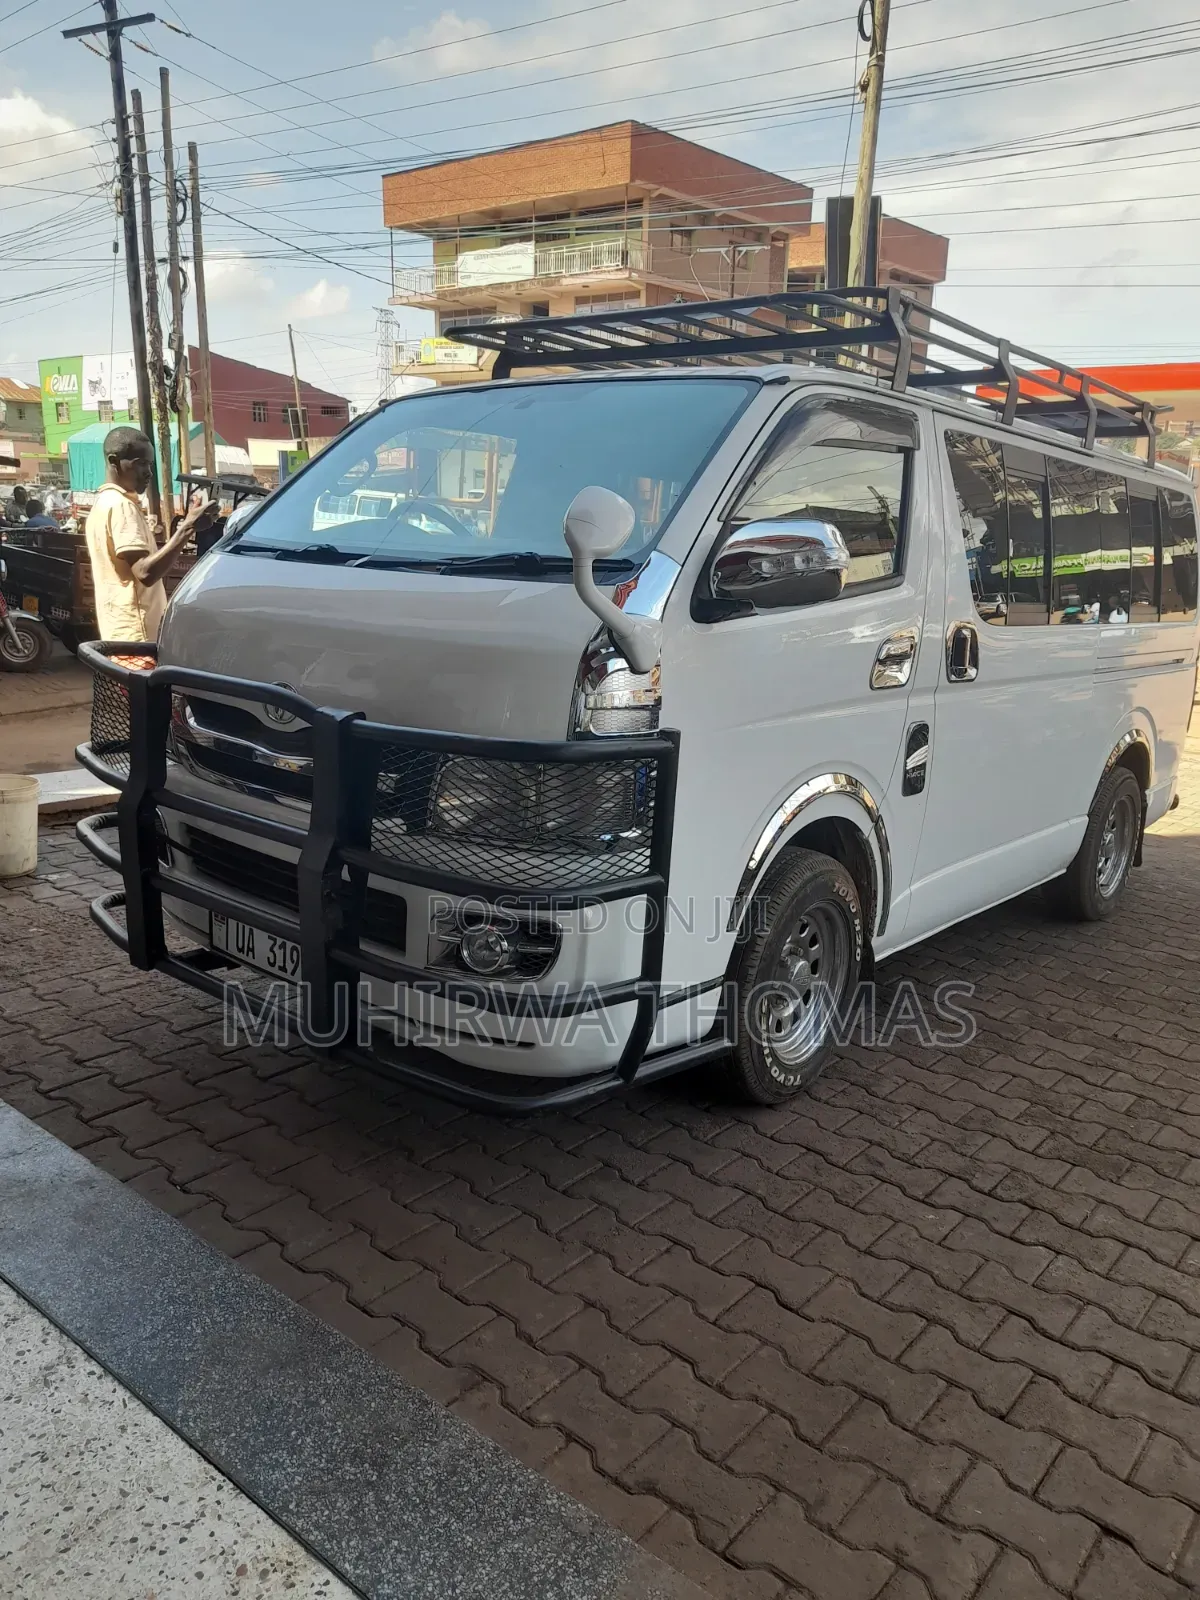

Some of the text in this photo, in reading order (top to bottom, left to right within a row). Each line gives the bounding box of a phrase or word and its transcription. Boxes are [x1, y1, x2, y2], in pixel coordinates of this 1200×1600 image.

[833, 881, 857, 913] TOYO
[236, 921, 300, 977] UA 319
